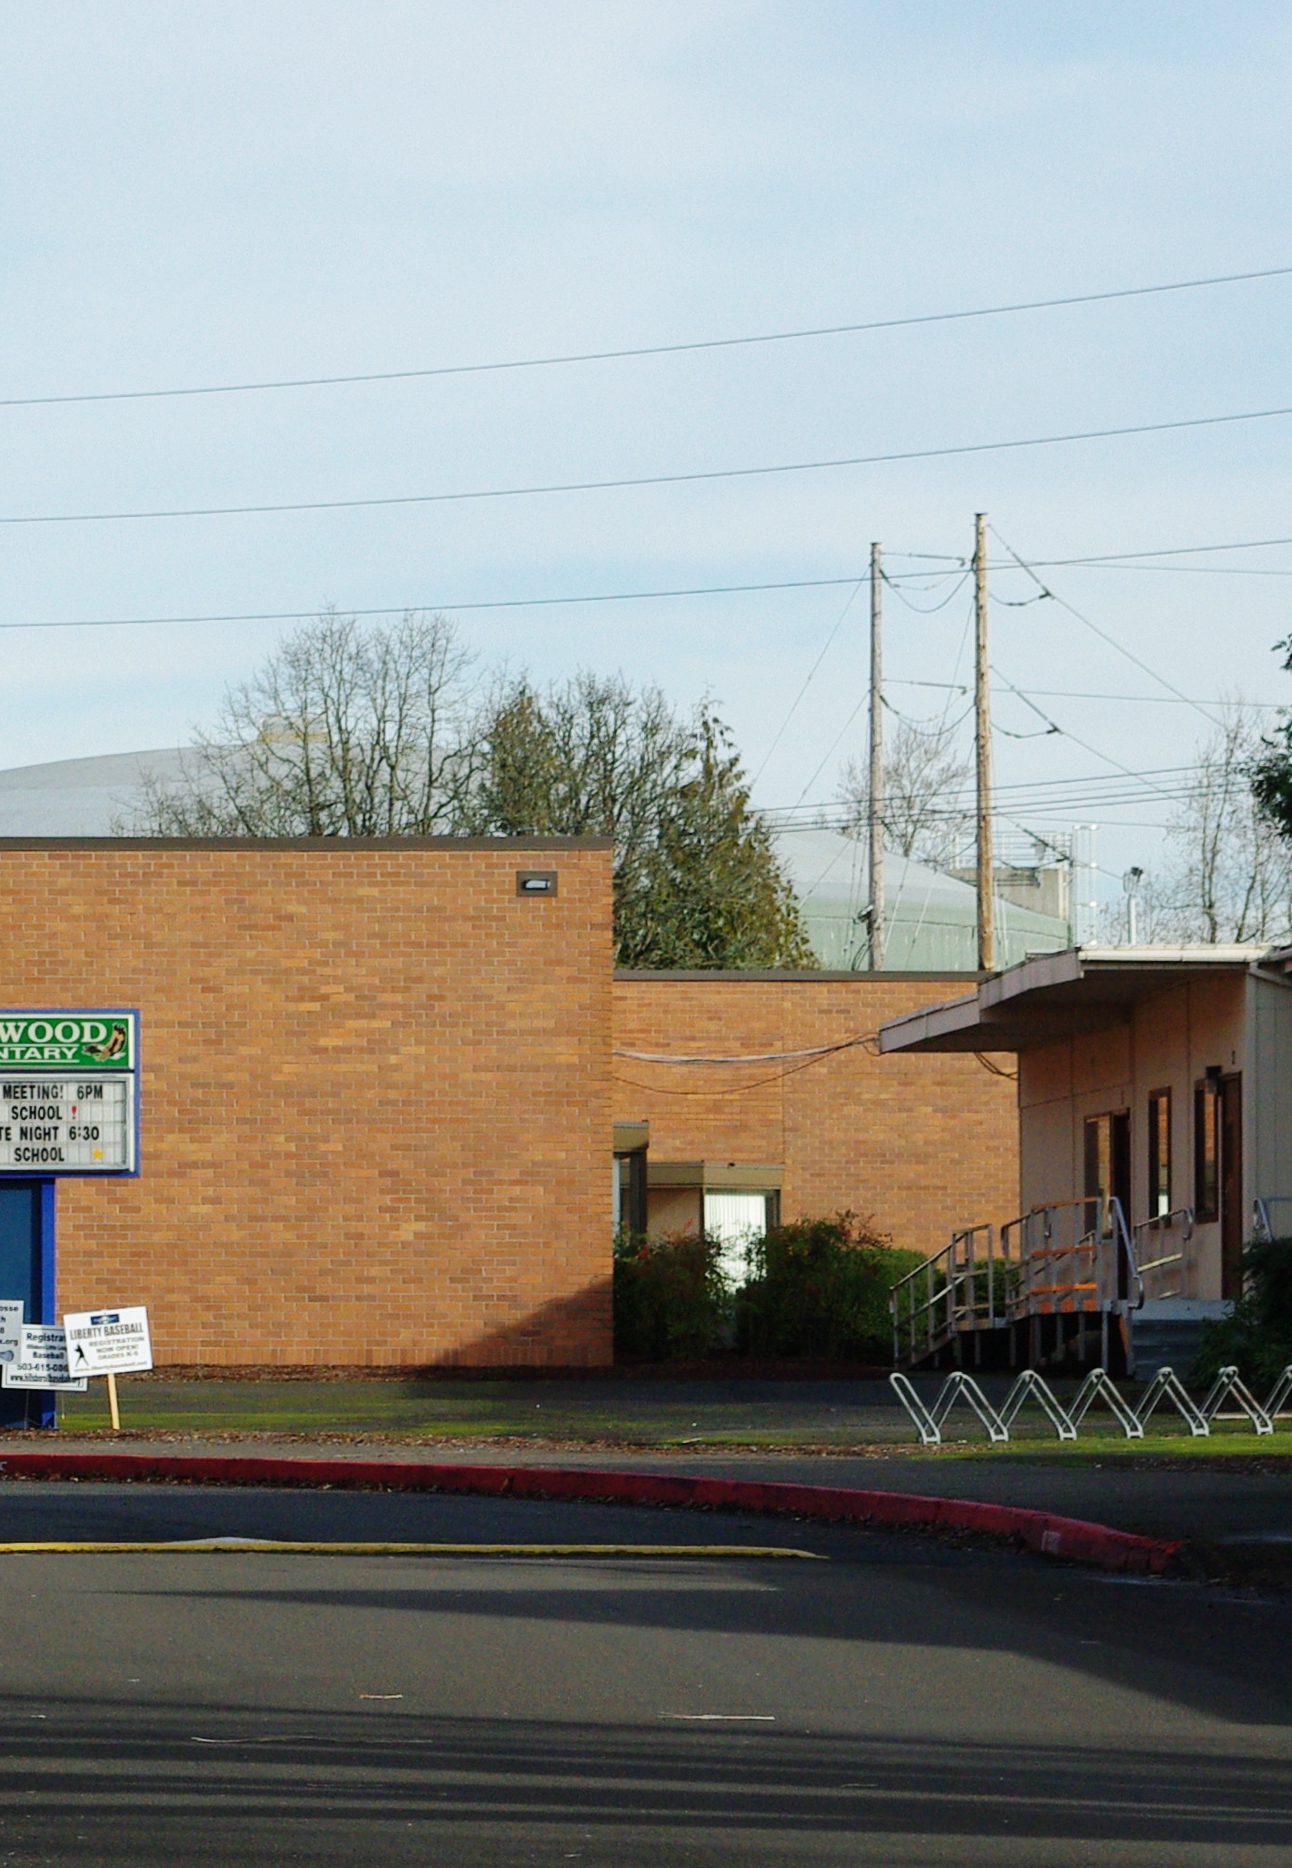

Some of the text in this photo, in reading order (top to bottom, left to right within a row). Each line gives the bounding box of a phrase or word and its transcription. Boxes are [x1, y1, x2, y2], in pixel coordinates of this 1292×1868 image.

[3, 1085, 64, 1100] MEETING!
[77, 1085, 103, 1099] 6PM
[11, 1106, 62, 1120] SCHOOL
[20, 1126, 59, 1141] NIGHT
[69, 1126, 99, 1140] 6:30
[14, 1147, 64, 1162] SCHOOL
[69, 1322, 144, 1340] LIBERTY BASEBALL
[88, 1336, 145, 1347] REGISTRATION
[33, 1351, 64, 1359] Baseball
